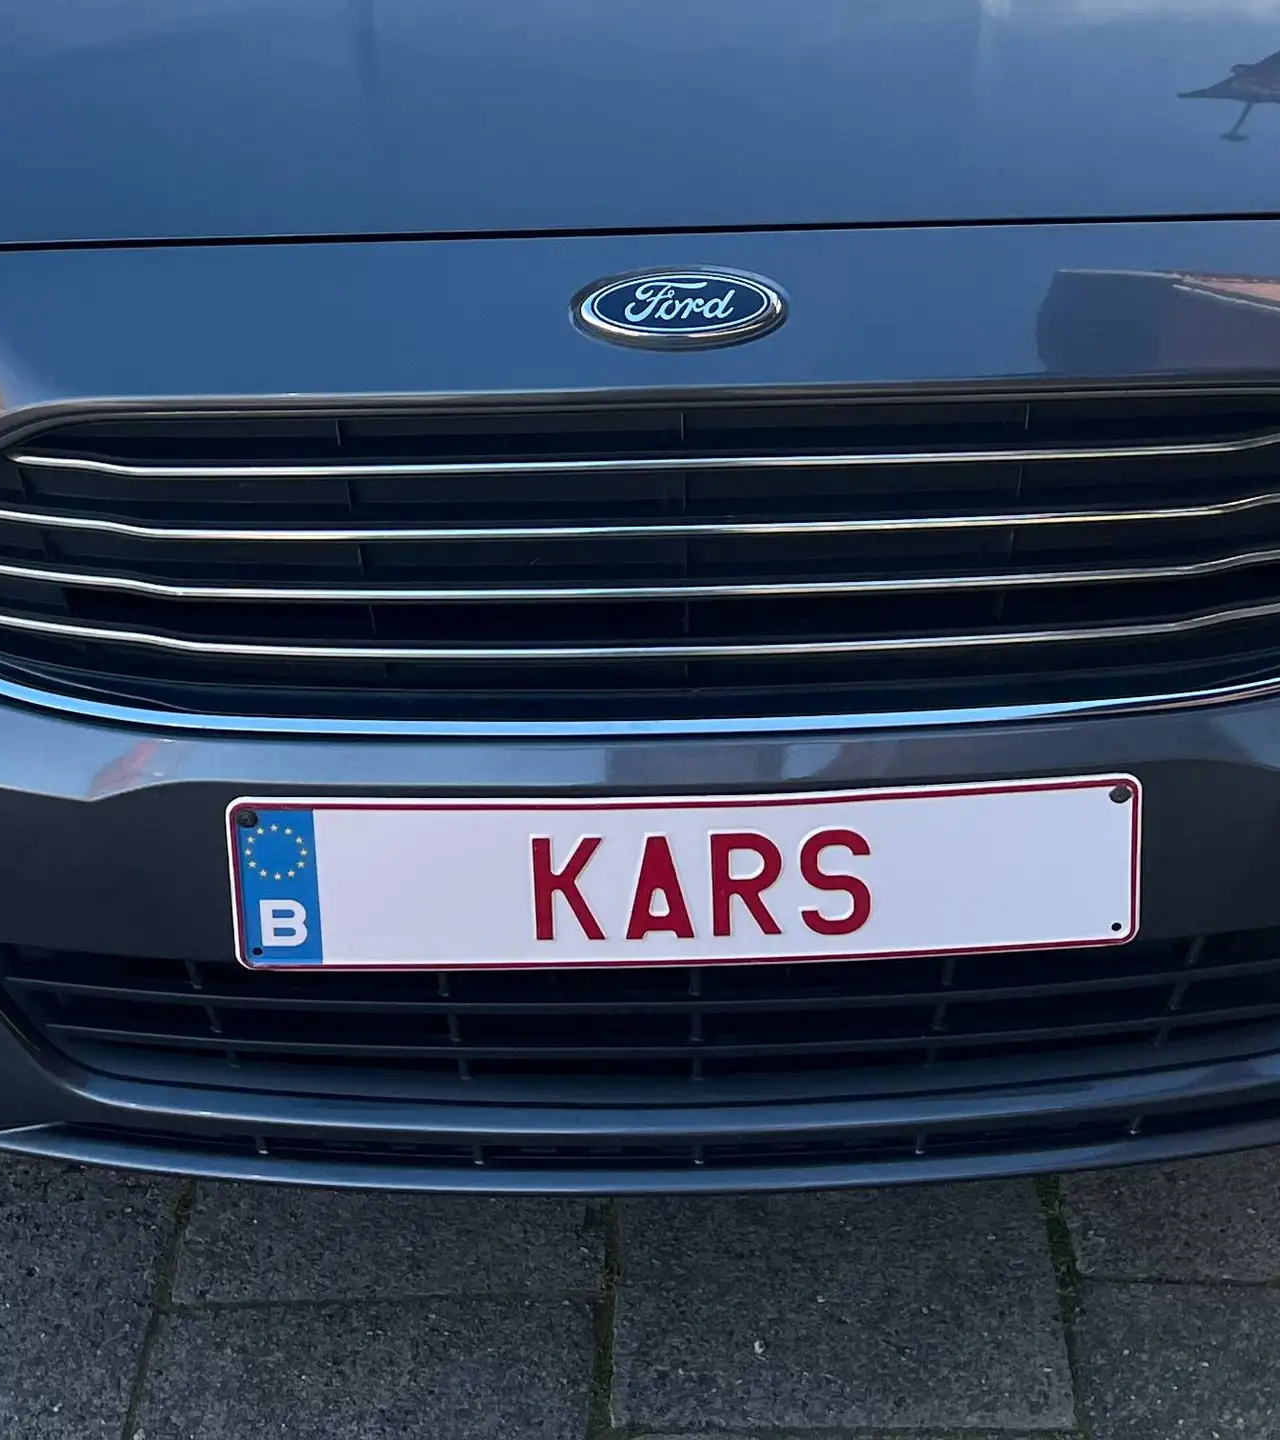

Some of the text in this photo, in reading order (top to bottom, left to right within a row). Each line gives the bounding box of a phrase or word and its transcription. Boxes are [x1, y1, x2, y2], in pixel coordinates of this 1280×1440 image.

[624, 281, 737, 323] Ford
[531, 827, 873, 941] KARS
[259, 899, 308, 947] B
